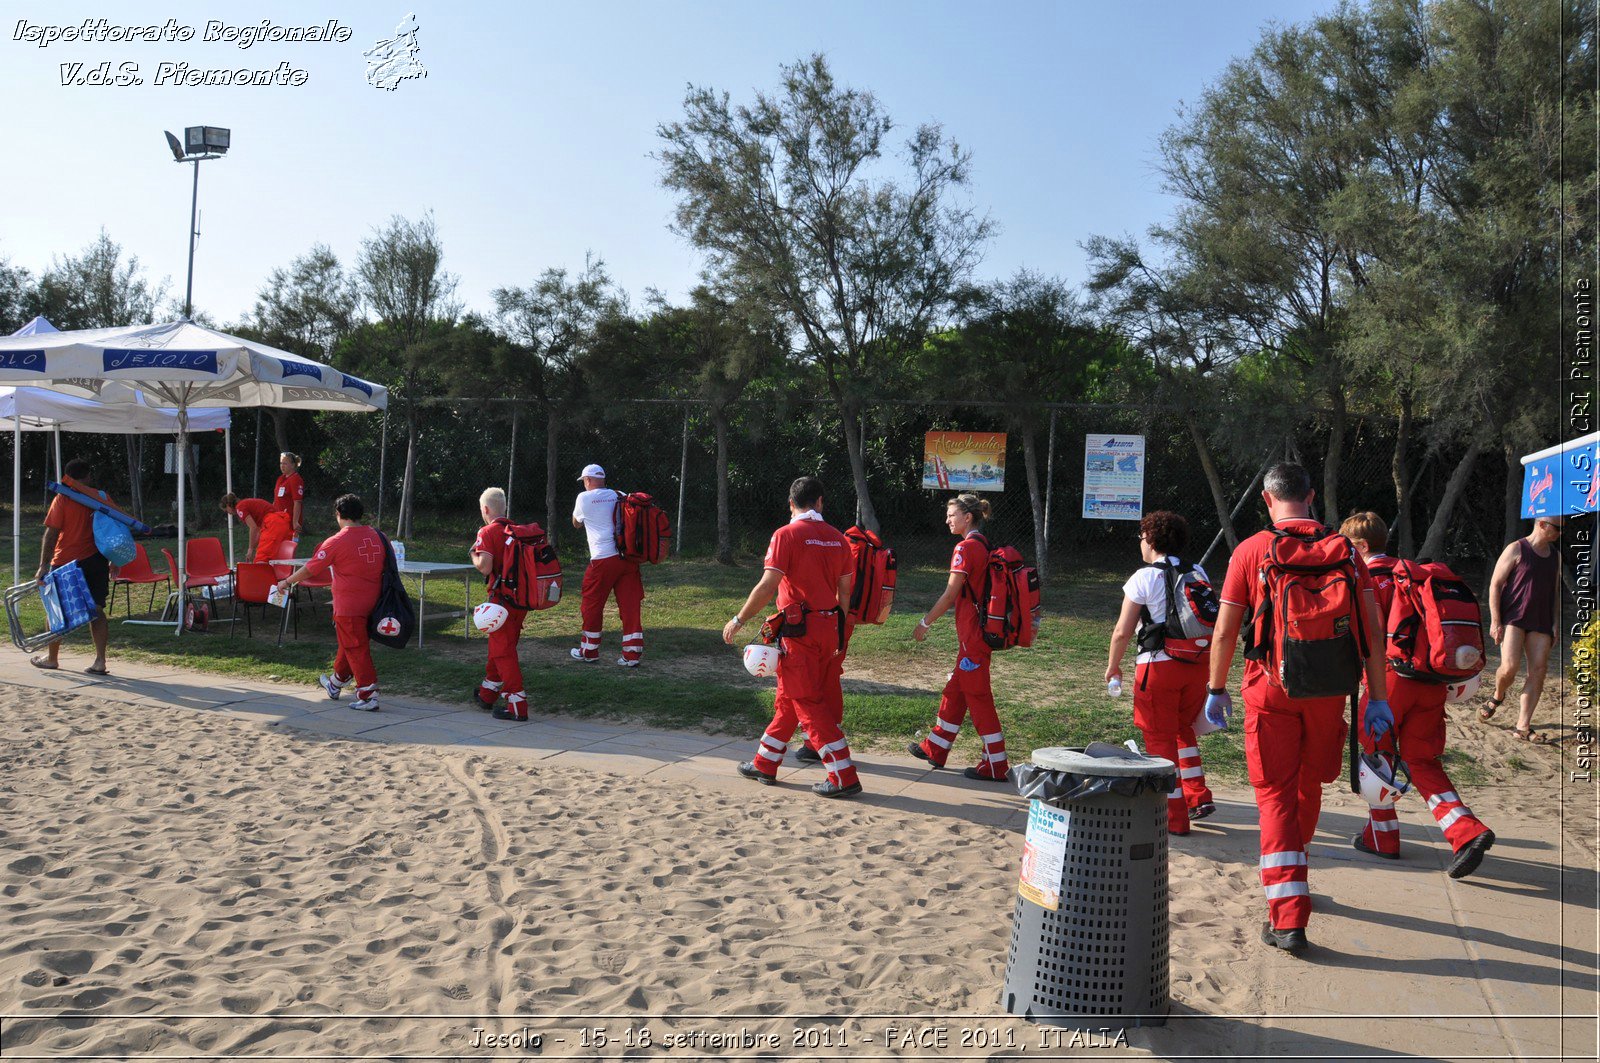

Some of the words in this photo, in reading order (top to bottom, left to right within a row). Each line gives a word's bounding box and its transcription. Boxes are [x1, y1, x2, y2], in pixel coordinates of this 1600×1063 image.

[110, 350, 209, 367] JESOLO
[1037, 817, 1054, 829] NON
[1039, 808, 1065, 823] SECCO
